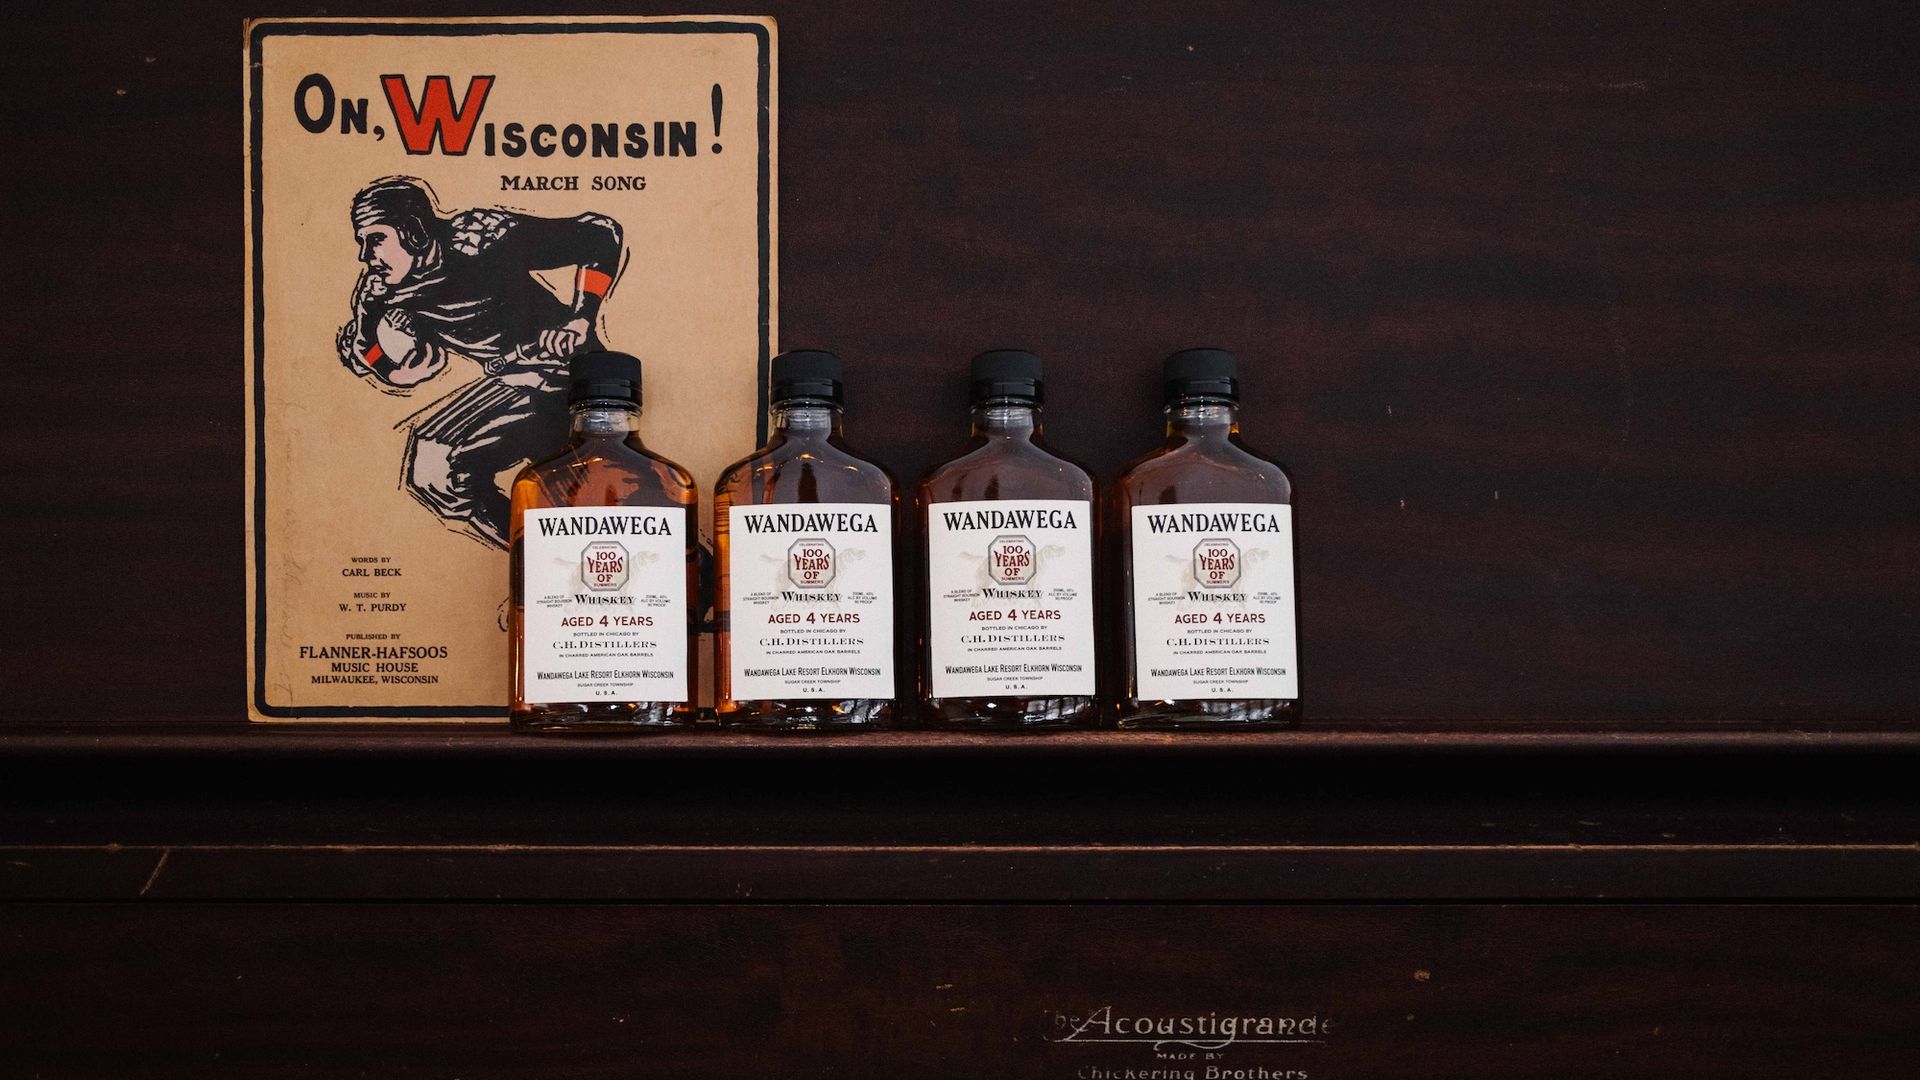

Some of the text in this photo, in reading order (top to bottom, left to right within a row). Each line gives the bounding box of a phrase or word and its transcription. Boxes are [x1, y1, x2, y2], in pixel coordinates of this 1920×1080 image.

[294, 73, 385, 142] ON,
[501, 175, 646, 192] MARCH SONG
[744, 513, 878, 534] WANDAWEGA
[944, 510, 1078, 530] WANDAWEGA
[1148, 513, 1282, 534] WANDAWEGA
[538, 516, 672, 537] WANDAWEGA
[803, 548, 823, 558] 100
[1003, 545, 1023, 554] 100
[1208, 548, 1228, 558] 100
[596, 551, 616, 561] 100
[993, 550, 1031, 567] YEARS
[1198, 553, 1236, 570] YEARS
[586, 556, 624, 573] YEARS
[793, 553, 830, 571] YEARS
[342, 568, 402, 577] CARL BECK
[803, 571, 820, 580] OF
[1004, 568, 1021, 576] OF
[1209, 571, 1226, 580] OF
[596, 574, 613, 583] OF
[781, 591, 842, 602] WHISKEY
[982, 588, 1043, 599] WHISKEY
[1187, 591, 1248, 602] WHISKEY
[574, 594, 635, 605] WHISKEY
[371, 603, 407, 612] PURDY
[768, 612, 861, 624] AGED 4 YEARS
[969, 609, 1062, 621] AGED 4 YEARS
[1174, 612, 1267, 624] AGED 4 YEARS
[561, 615, 654, 627] AGED 4 YEARS
[299, 646, 448, 659] FLANNER-HAFSOOS
[331, 662, 419, 673] MUSIC HOUSE
[311, 675, 439, 685] MILWAUKEE, WISCONSIN
[1205, 1066, 1309, 1080] Brothers
